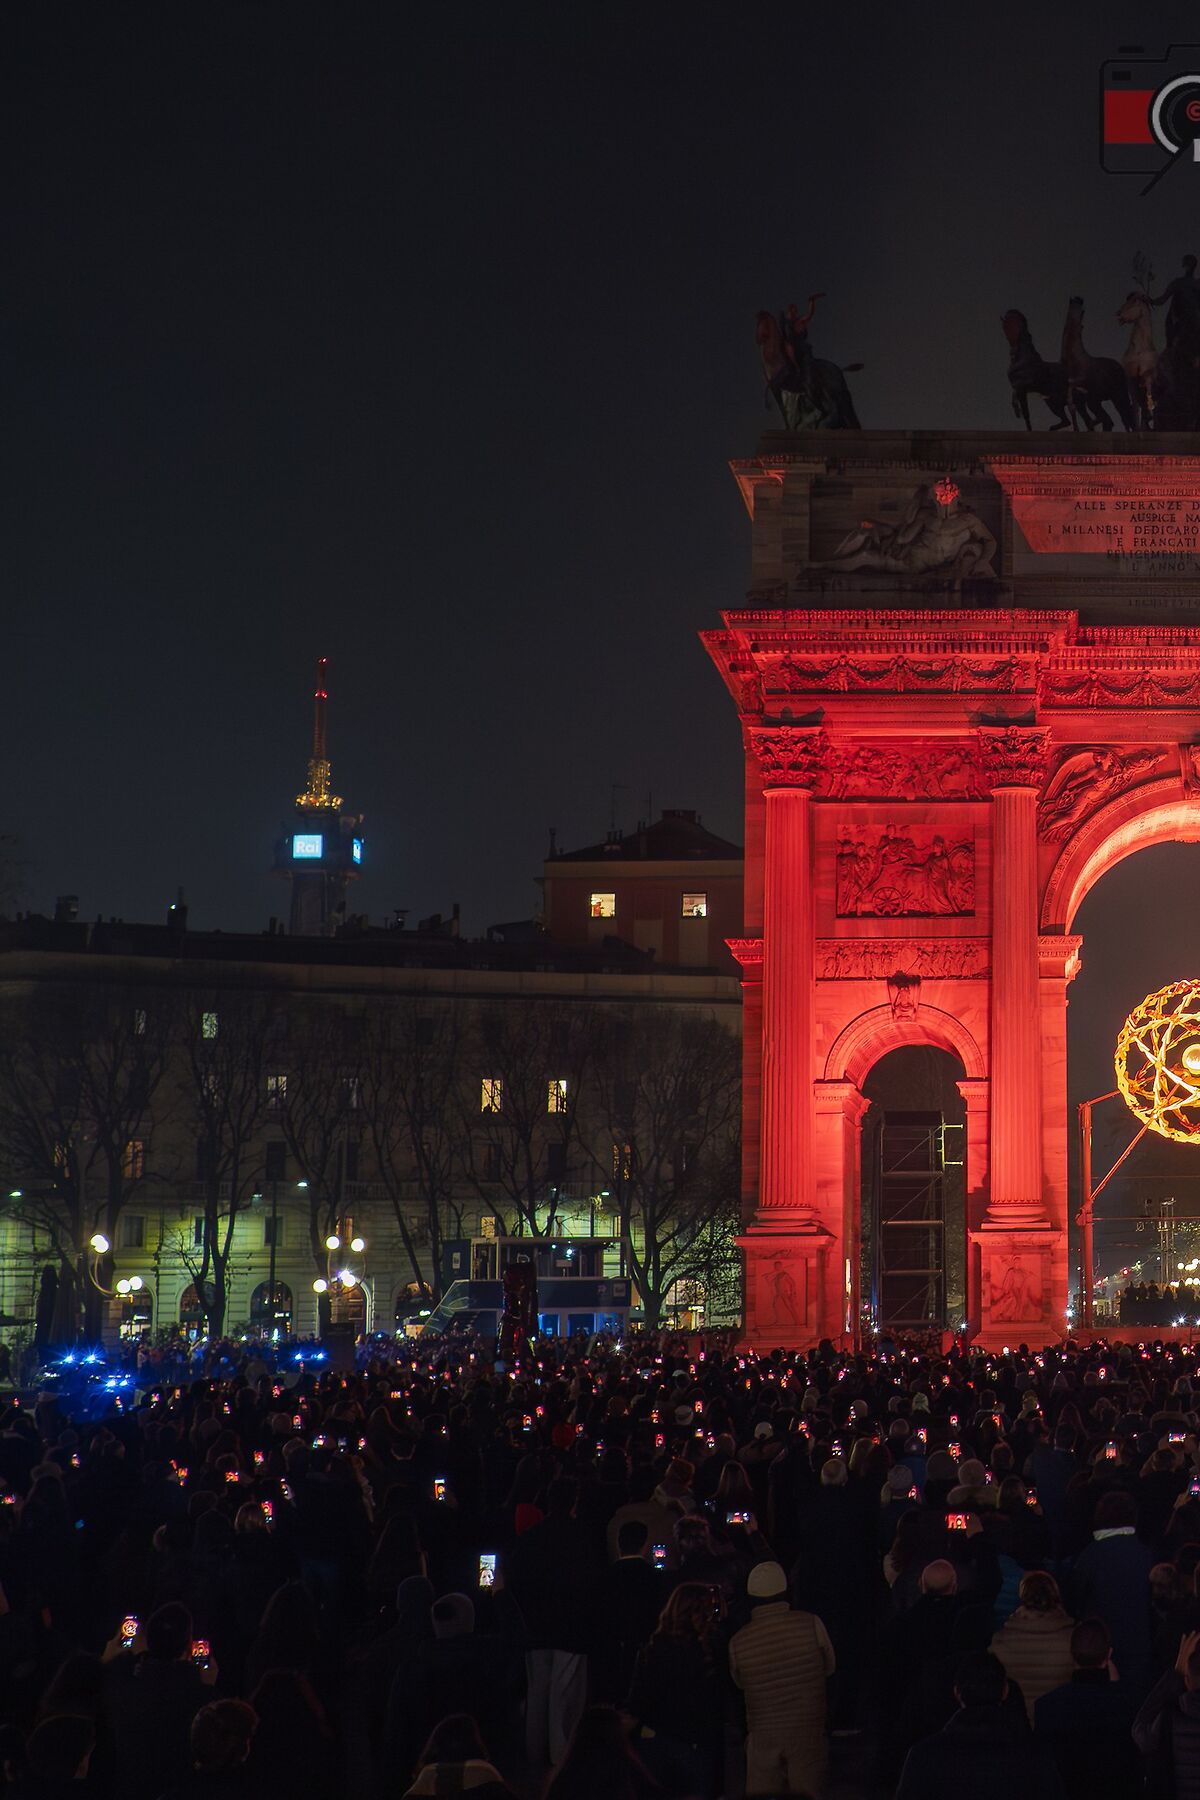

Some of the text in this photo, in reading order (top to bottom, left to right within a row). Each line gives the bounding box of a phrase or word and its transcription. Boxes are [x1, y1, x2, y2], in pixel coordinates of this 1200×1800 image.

[1074, 501, 1106, 511] ALLE
[1114, 501, 1182, 511] SPERANZE
[1130, 513, 1176, 523] AUSPICE
[1062, 525, 1124, 535] MILANESI
[1117, 537, 1124, 547] E
[1133, 537, 1196, 547] FRANCATI
[296, 840, 319, 854] Rai
